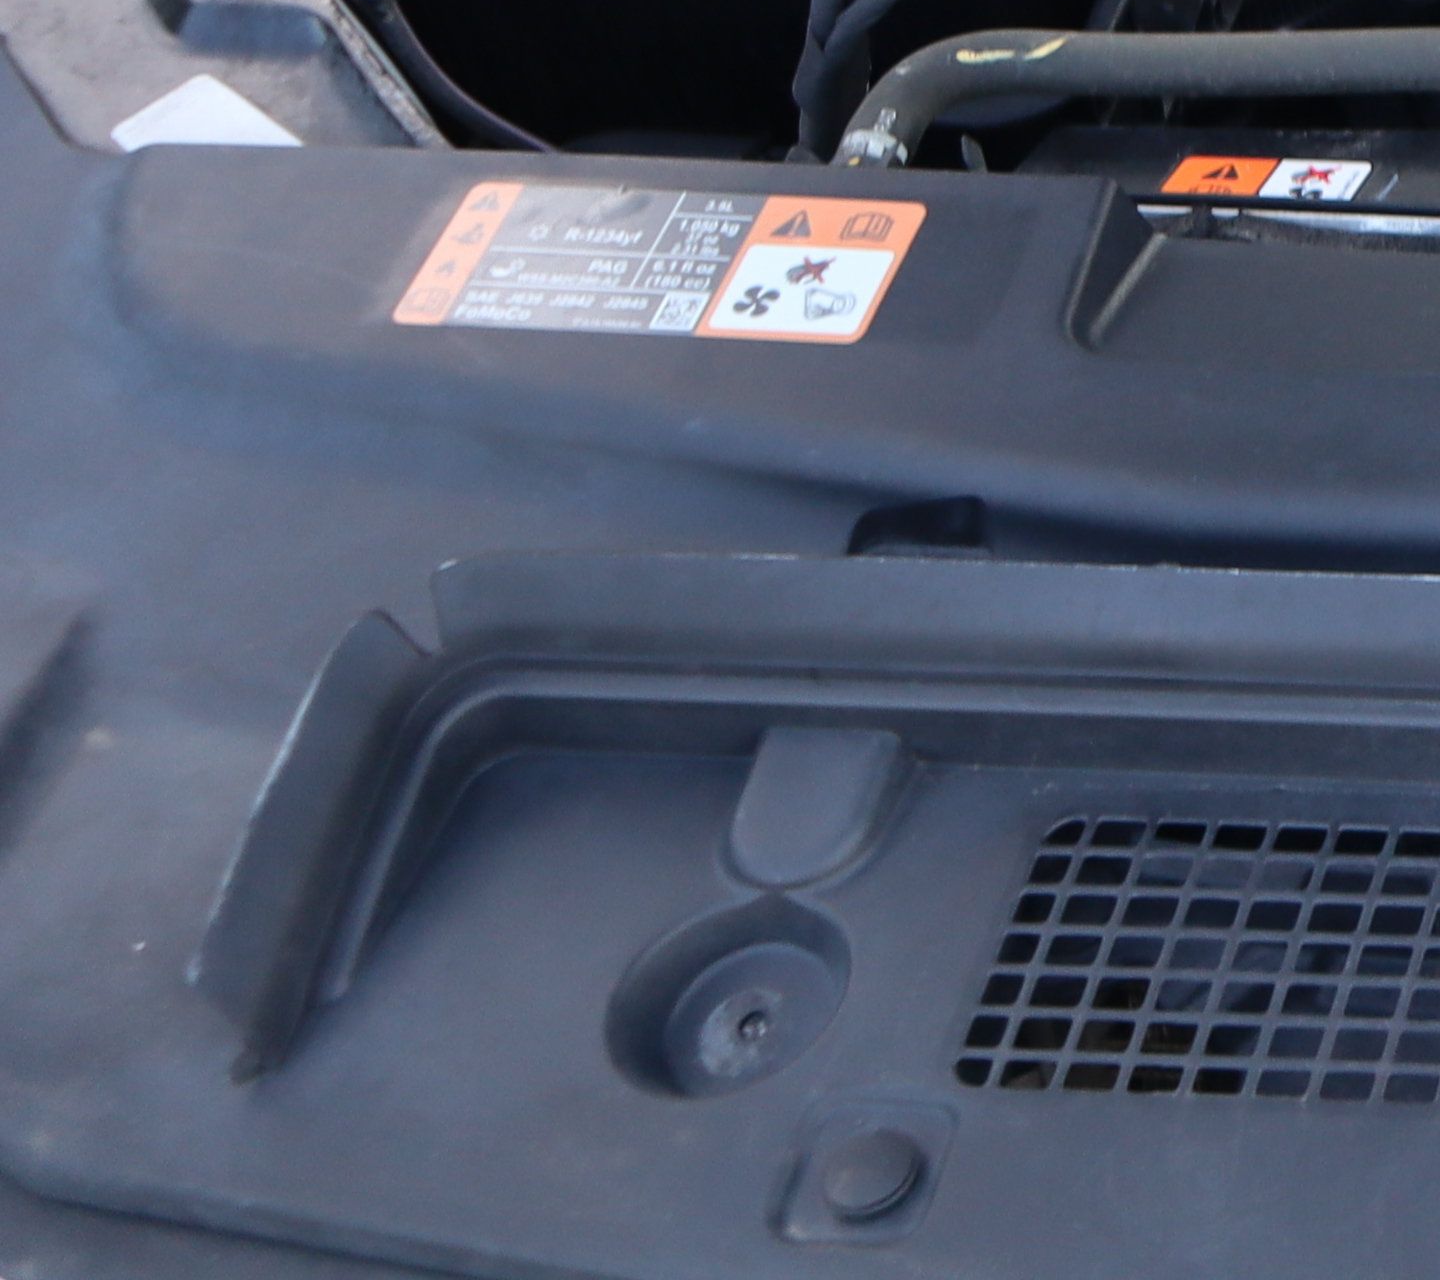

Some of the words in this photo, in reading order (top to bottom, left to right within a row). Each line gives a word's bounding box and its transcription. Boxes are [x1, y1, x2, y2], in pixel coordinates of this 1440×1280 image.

[563, 225, 643, 247] R-1234yf
[720, 221, 740, 238] kg
[587, 259, 628, 274] PAG
[696, 263, 717, 275] oz
[464, 290, 500, 303] SAE
[453, 304, 532, 321] FoMoCo
